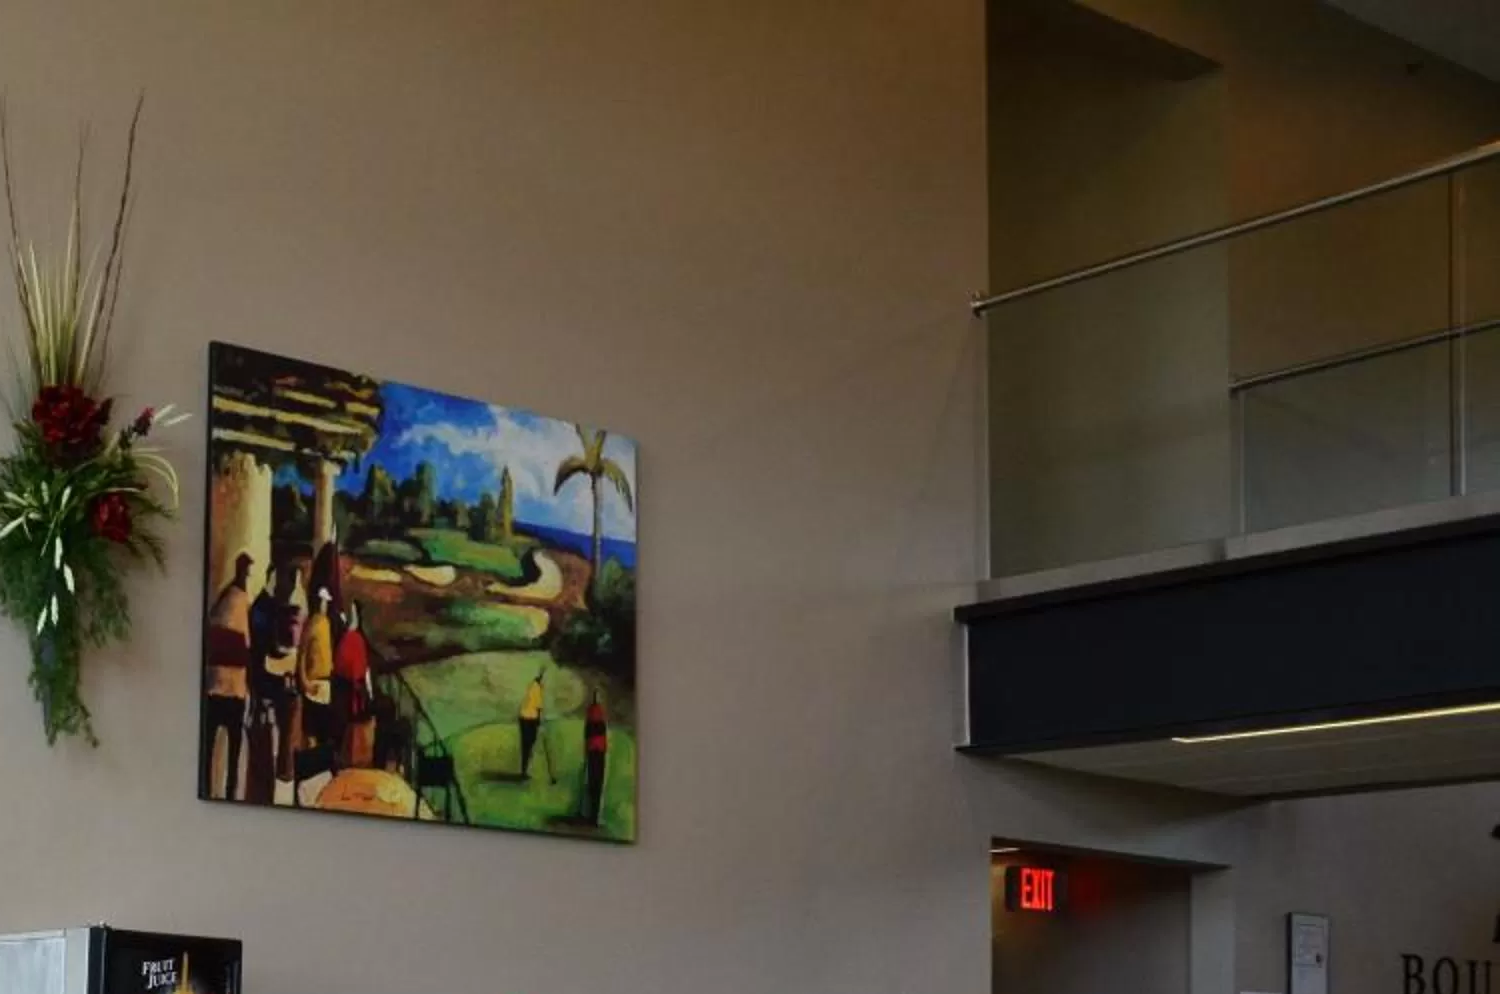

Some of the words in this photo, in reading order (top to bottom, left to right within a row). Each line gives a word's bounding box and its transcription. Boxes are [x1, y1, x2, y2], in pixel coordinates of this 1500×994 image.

[1021, 867, 1054, 911] EXIT
[141, 958, 175, 976] FRUIT
[147, 971, 177, 989] JUICE
